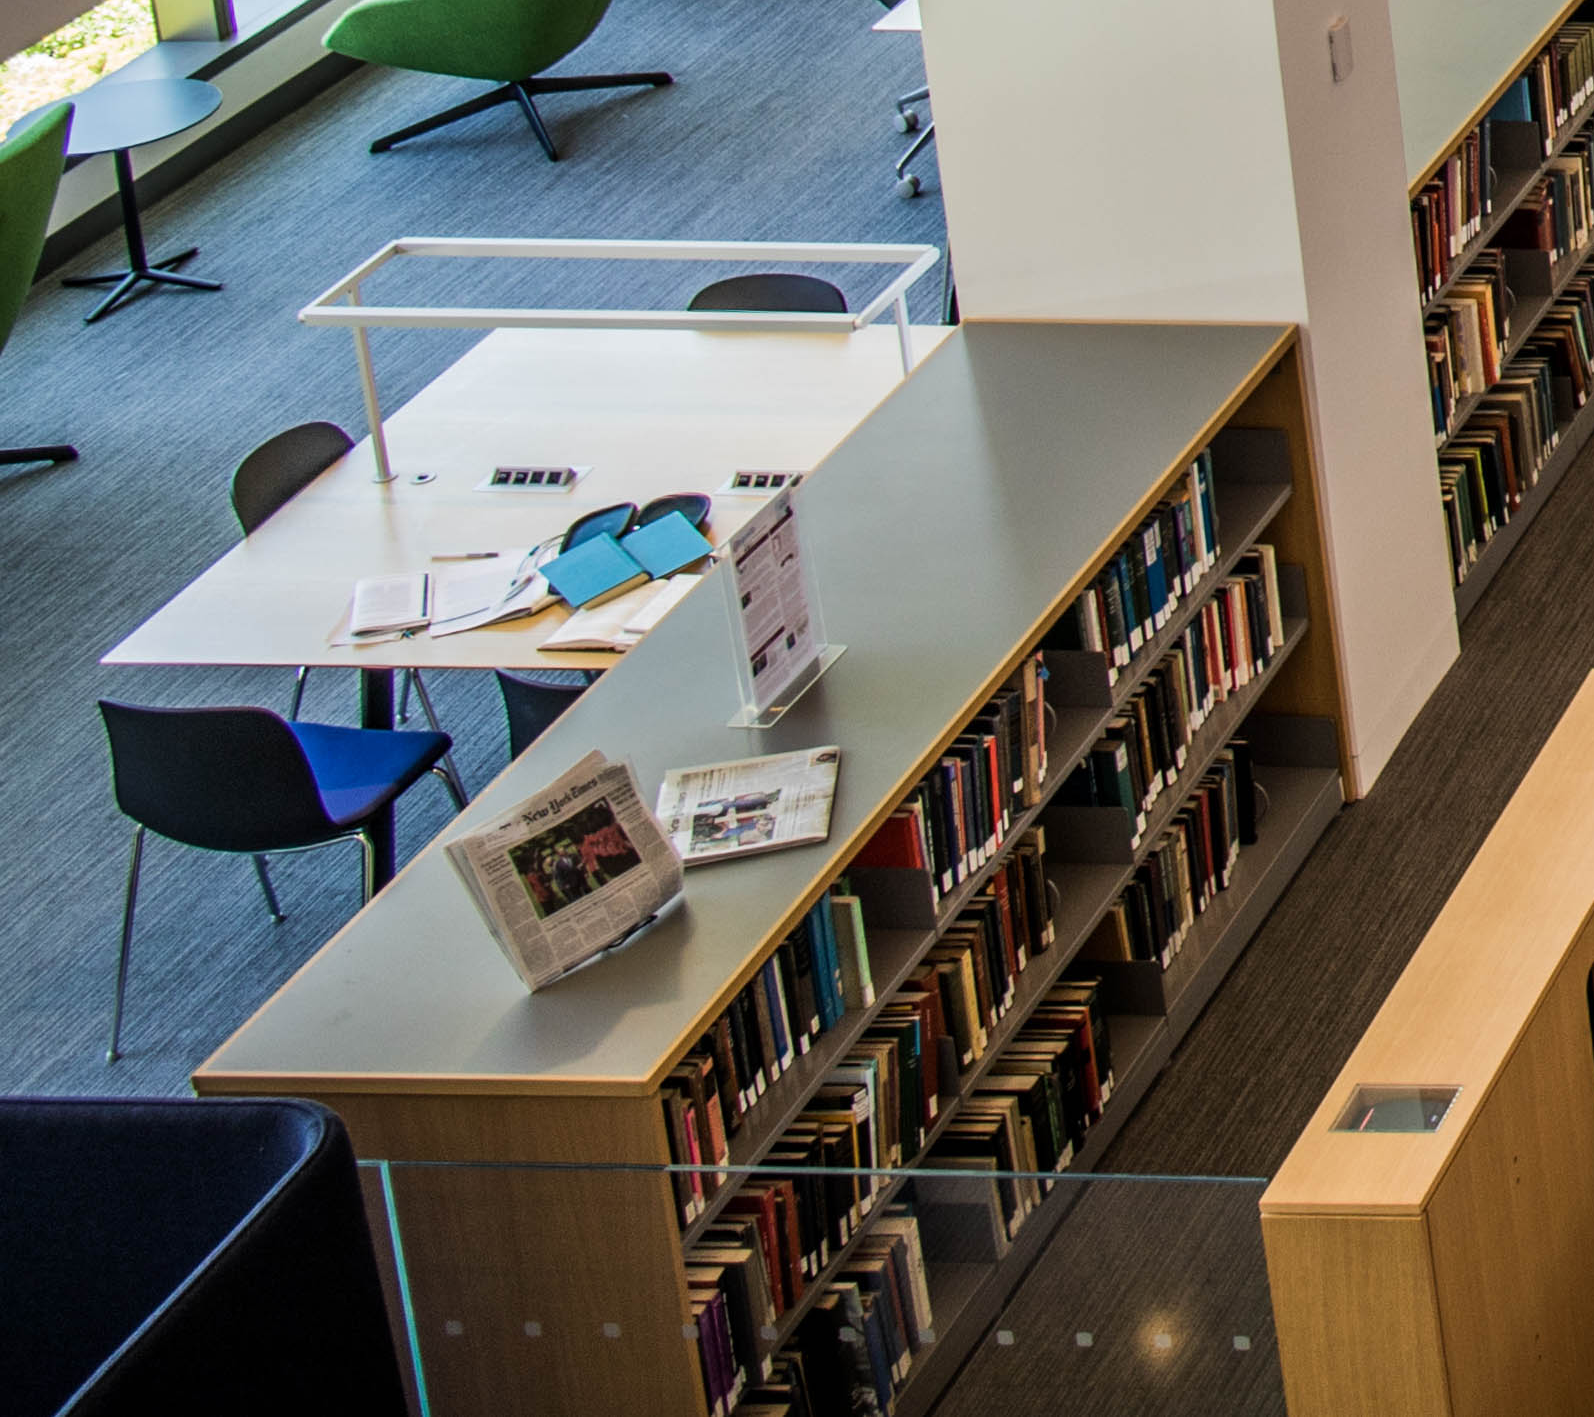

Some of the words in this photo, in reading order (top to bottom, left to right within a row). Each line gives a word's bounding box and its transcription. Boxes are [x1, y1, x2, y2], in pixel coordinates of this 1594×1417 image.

[522, 809, 550, 826] New
[548, 793, 573, 815] York
[570, 777, 598, 800] Times
